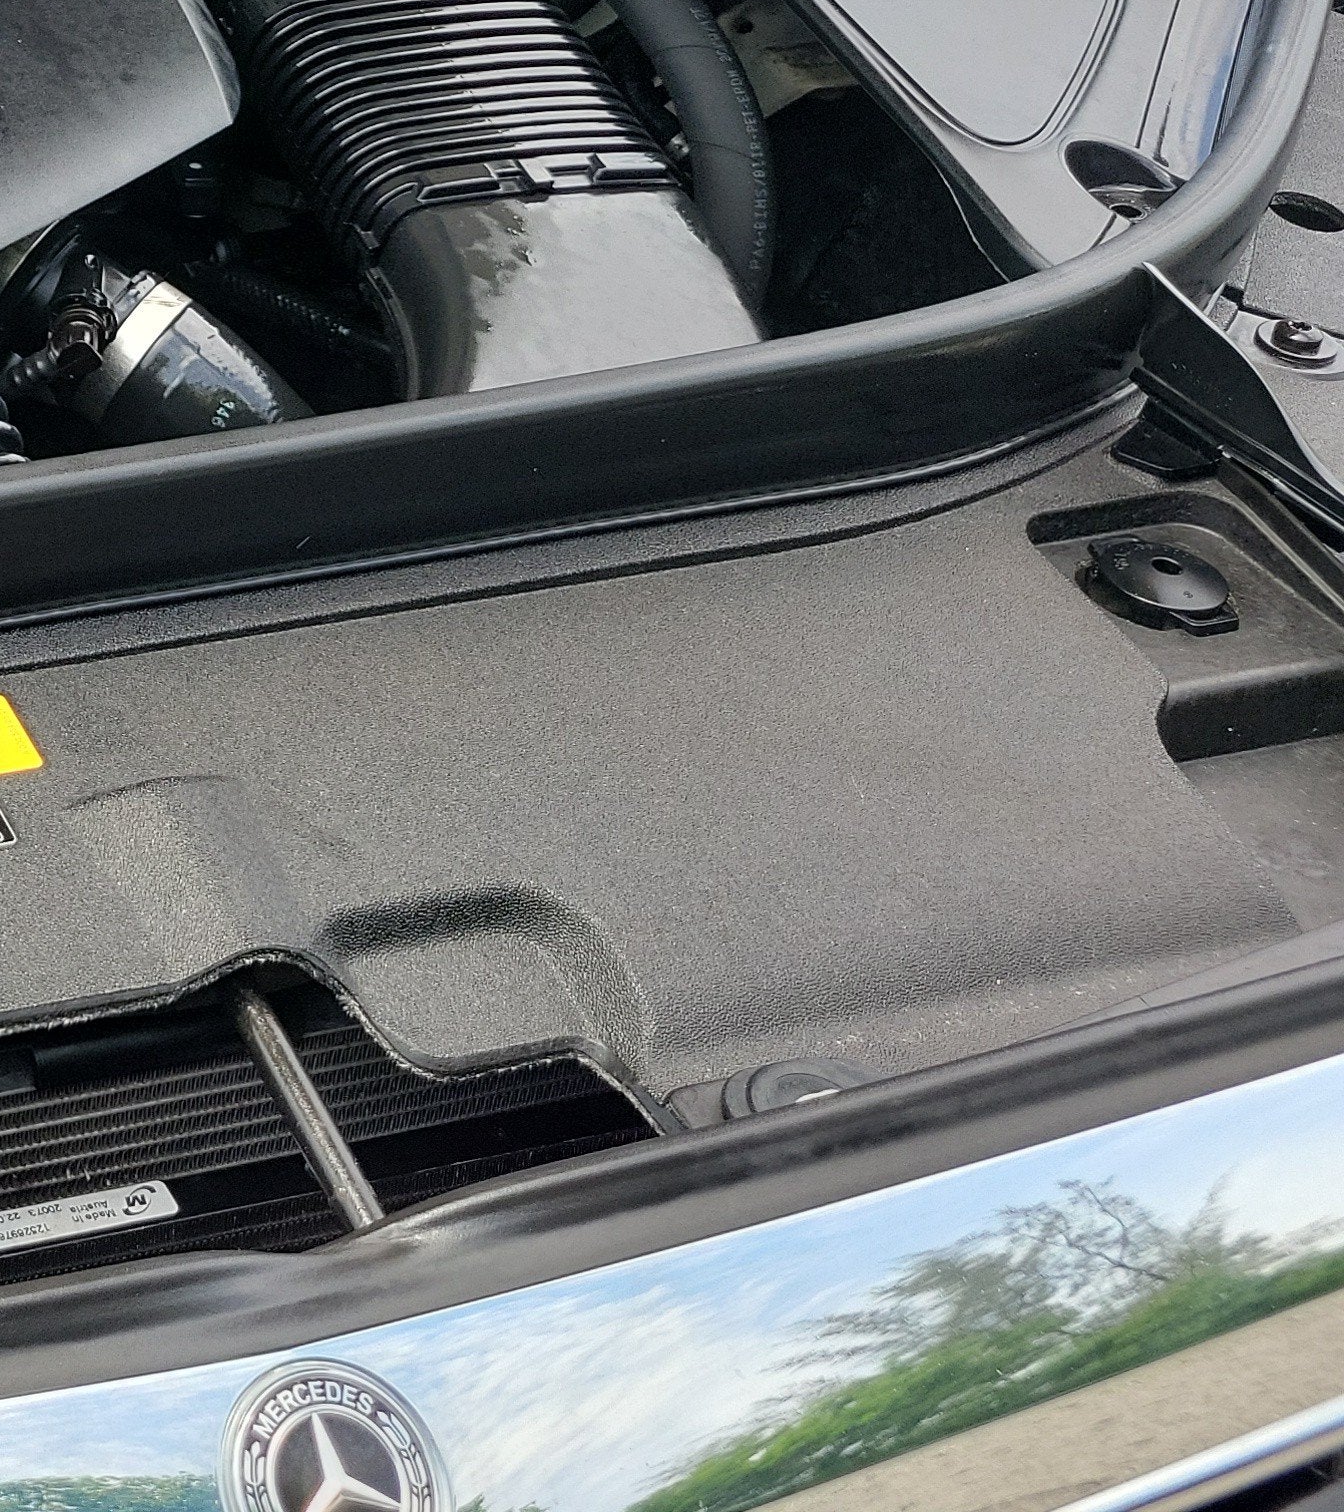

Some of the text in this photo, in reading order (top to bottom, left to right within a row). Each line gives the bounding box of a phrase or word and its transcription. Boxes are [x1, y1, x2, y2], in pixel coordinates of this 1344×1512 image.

[70, 1199, 108, 1213] Austria
[85, 1208, 117, 1223] Made
[252, 1380, 374, 1439] MERCEDES
